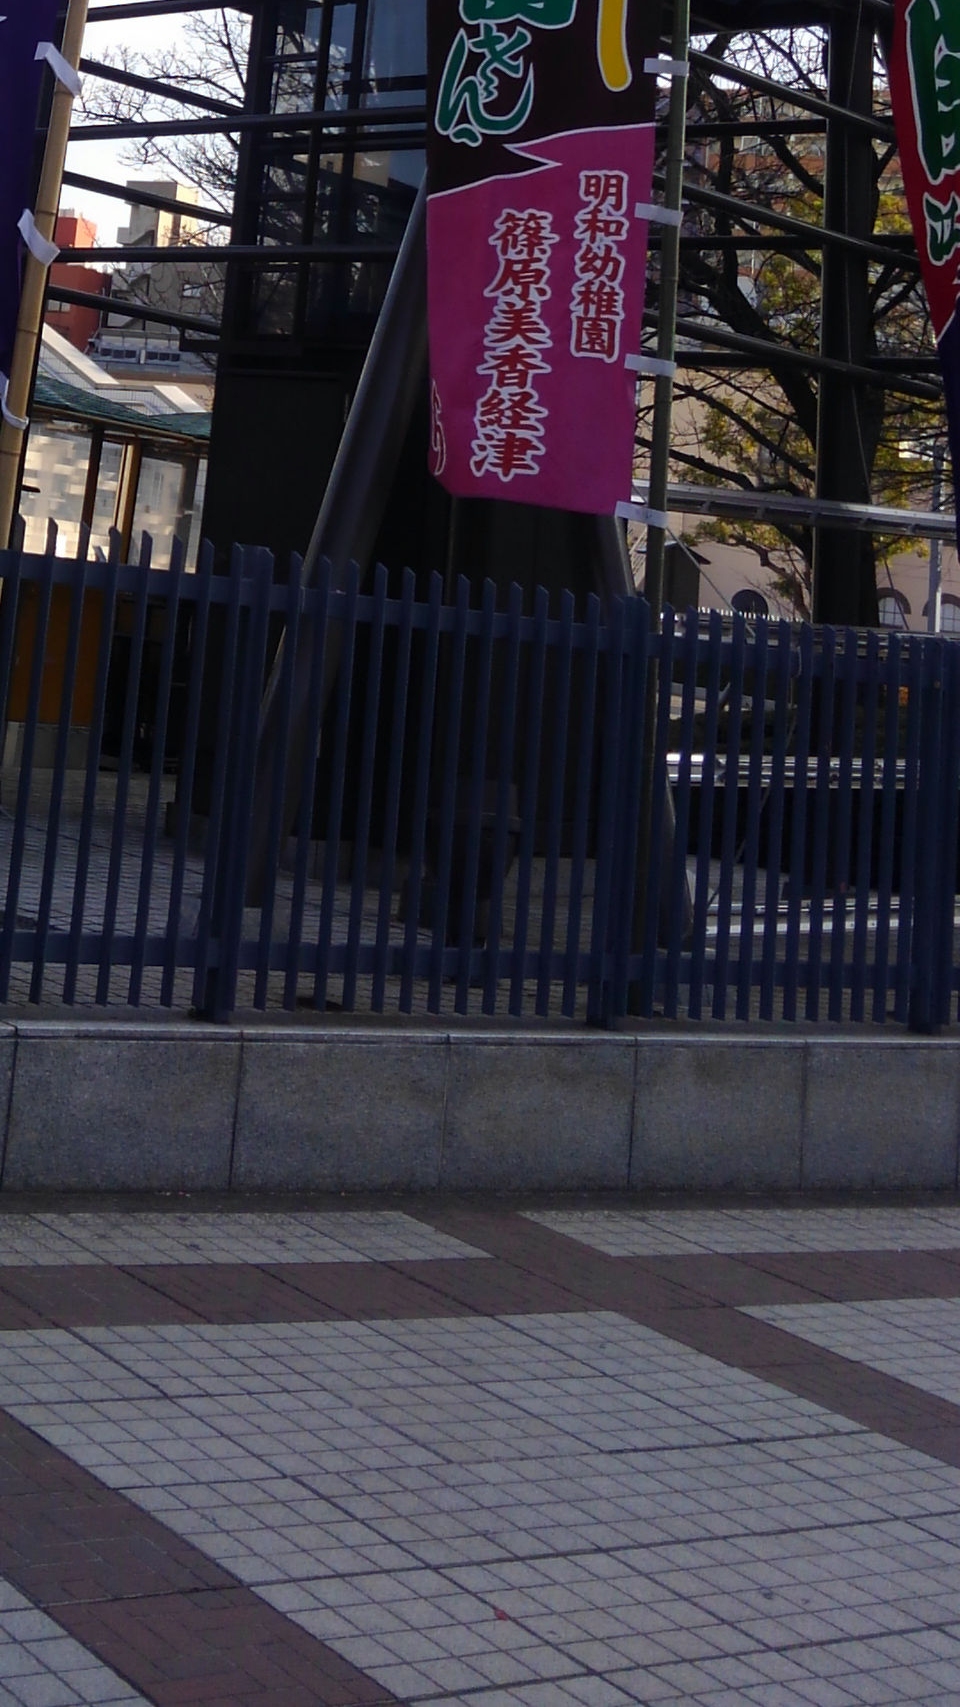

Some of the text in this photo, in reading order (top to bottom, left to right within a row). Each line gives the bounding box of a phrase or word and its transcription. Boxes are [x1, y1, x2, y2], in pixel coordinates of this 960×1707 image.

[470, 208, 560, 482] 篠原美香経津
[570, 170, 628, 363] 明和幼稚園
